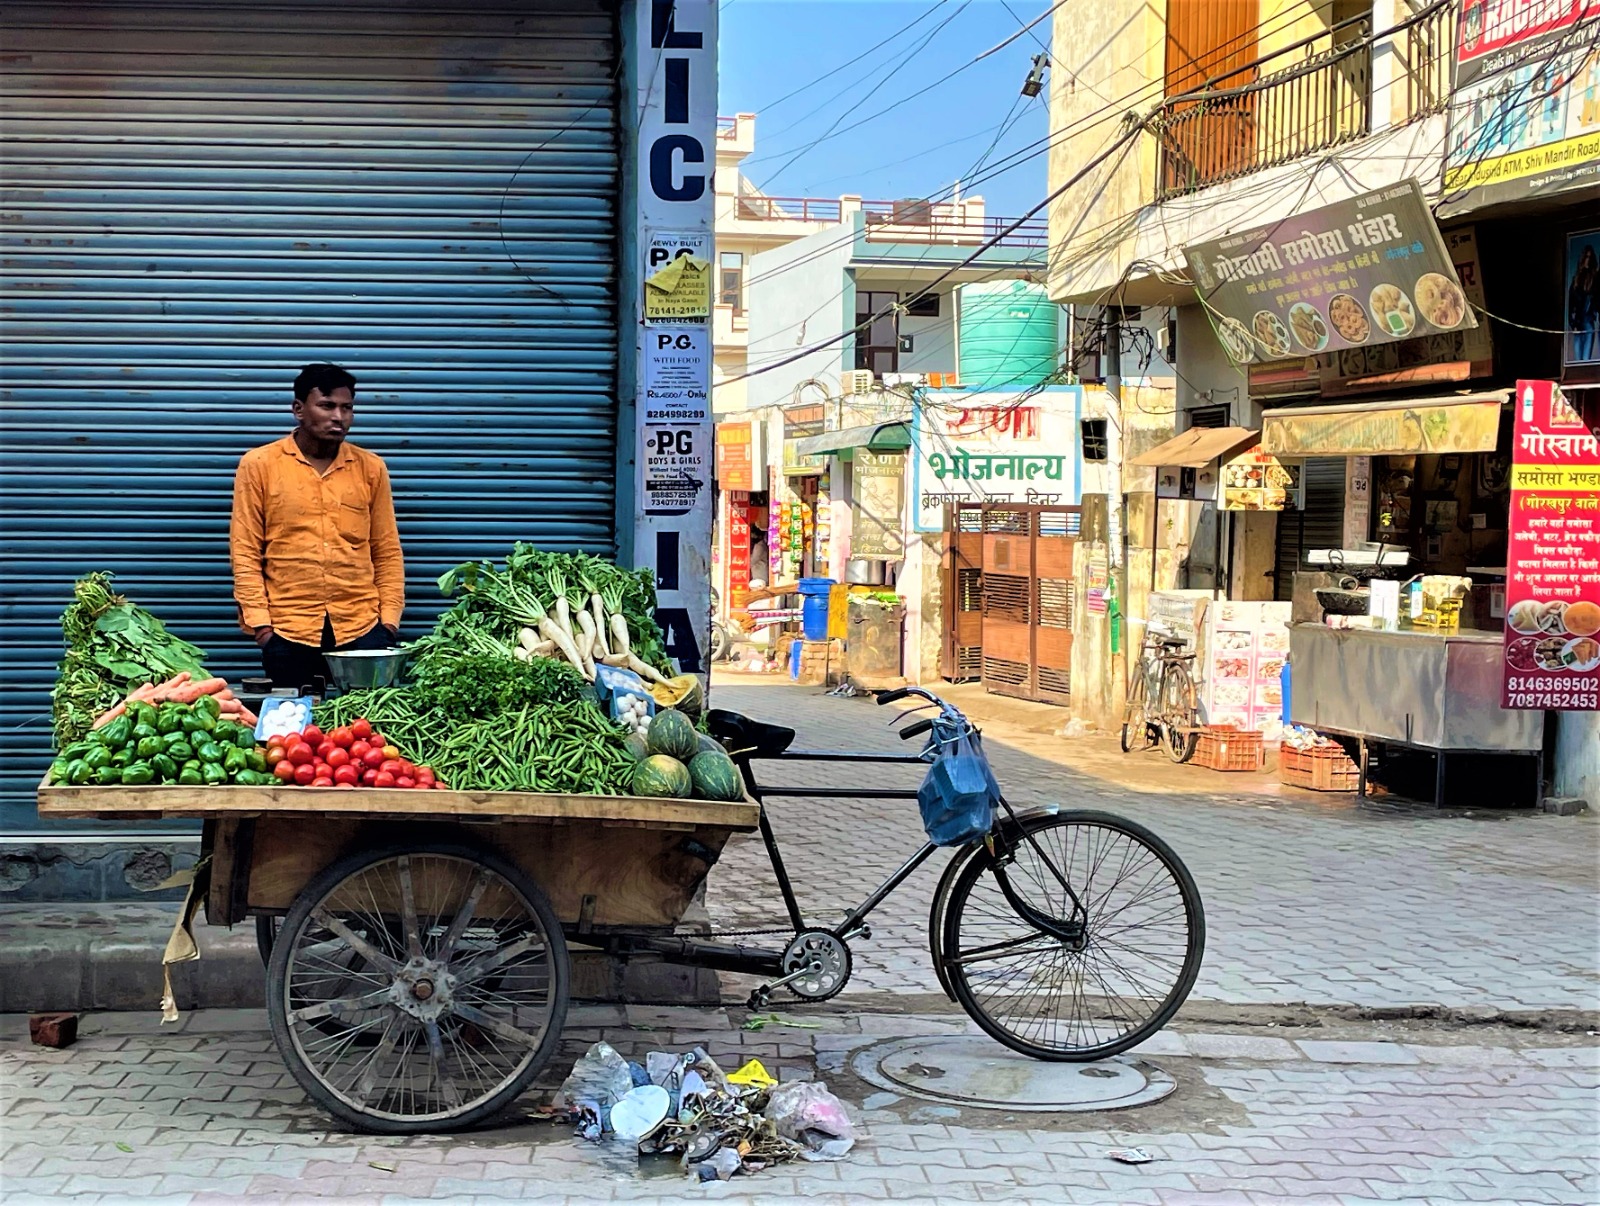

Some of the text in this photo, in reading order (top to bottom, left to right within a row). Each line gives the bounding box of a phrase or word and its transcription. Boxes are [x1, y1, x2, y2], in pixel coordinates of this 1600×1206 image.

[1481, 53, 1504, 73] Deals
[1503, 158, 1523, 176] ATM,
[1525, 153, 1541, 170] Shiv
[1544, 143, 1575, 164] Mandir
[1212, 239, 1284, 283] गोस्वामी
[1281, 229, 1348, 267] समोसा
[1348, 214, 1403, 248] भंडार
[657, 334, 696, 350] P.G.
[656, 430, 692, 455] PG
[648, 457, 701, 465] BOYS & GIRLS
[858, 453, 901, 466] राणा
[928, 446, 1066, 480] भोजनाल्य
[1517, 466, 1563, 486] समोसा
[1575, 494, 1599, 509] वाले
[1566, 517, 1593, 528] समोसा
[1508, 677, 1599, 691] 8146369502
[1508, 693, 1598, 708] 7087452453
